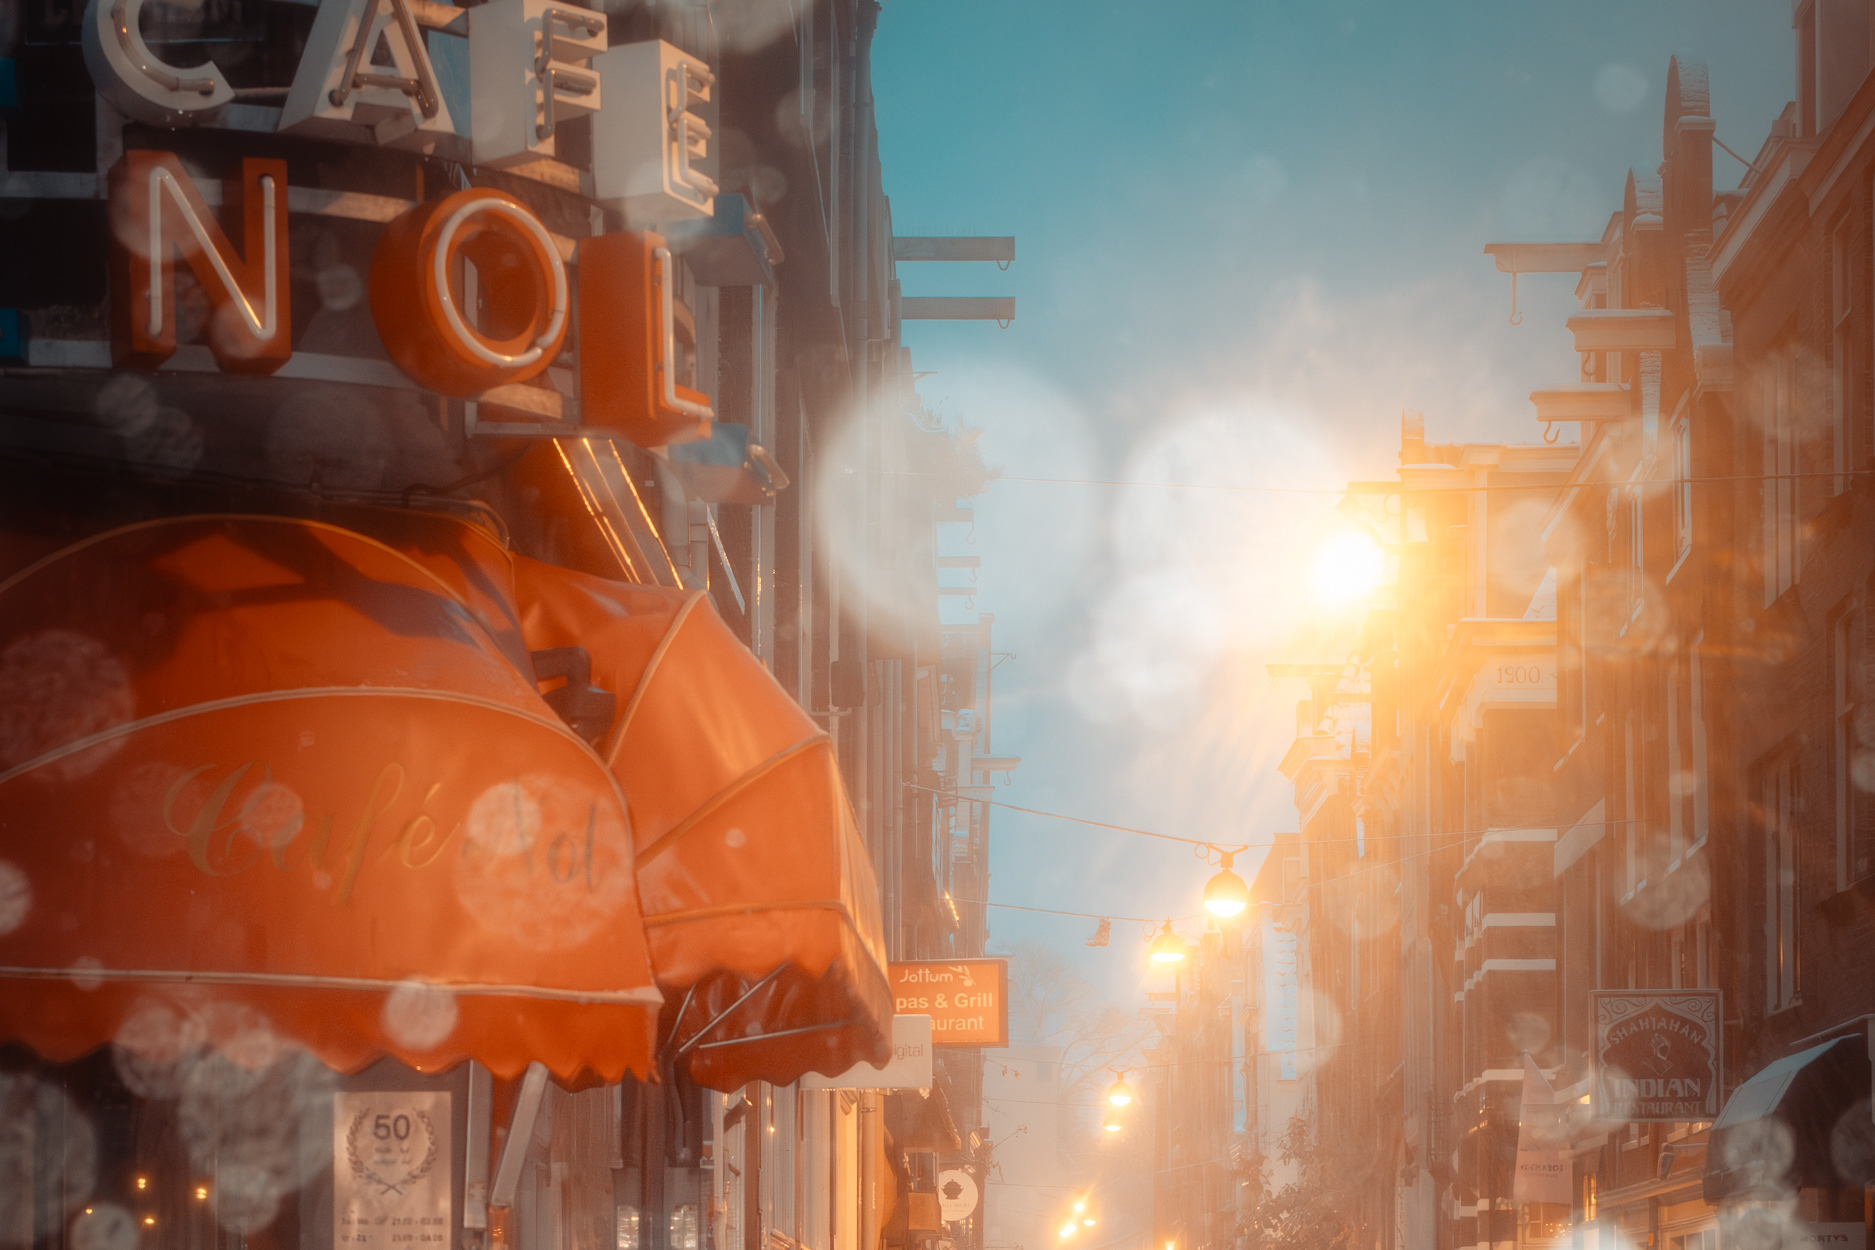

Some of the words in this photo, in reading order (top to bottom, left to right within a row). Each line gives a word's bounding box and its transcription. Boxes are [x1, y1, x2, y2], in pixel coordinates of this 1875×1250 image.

[82, 0, 715, 218] CAFE
[108, 148, 714, 447] NOL
[899, 967, 954, 983] Jottum
[895, 996, 930, 1012] pas
[935, 993, 949, 1008] &
[954, 992, 993, 1008] Grill
[930, 1016, 985, 1031] aurant
[893, 1043, 924, 1061] igital
[1612, 1078, 1700, 1098] INDIAN
[373, 1114, 411, 1141] 50
